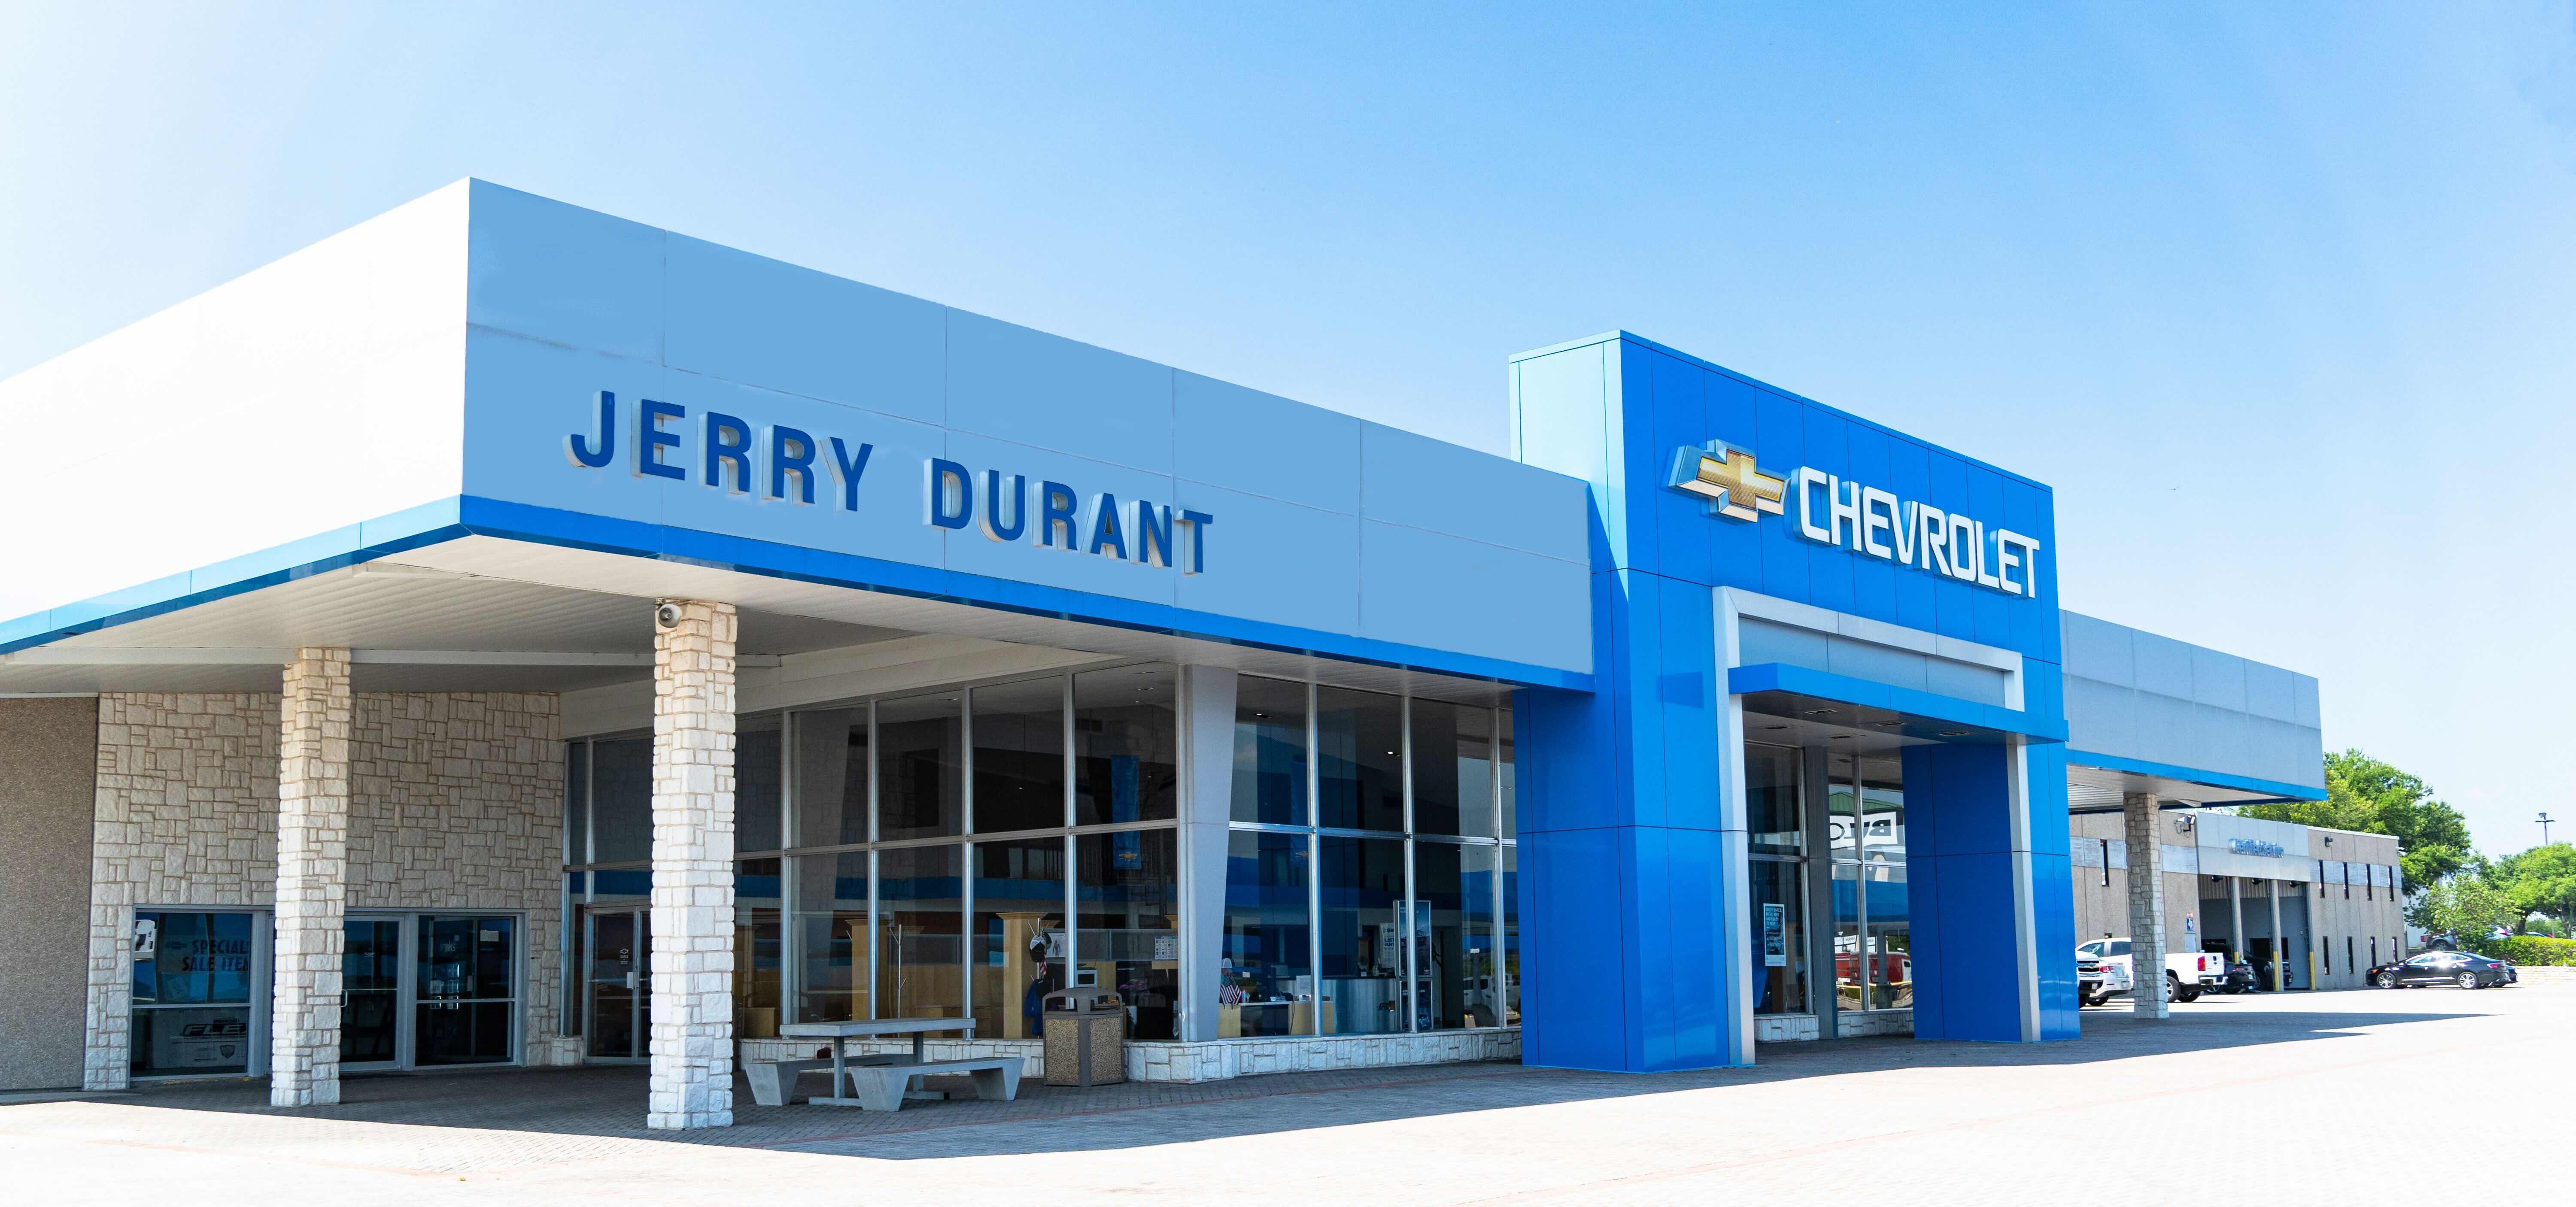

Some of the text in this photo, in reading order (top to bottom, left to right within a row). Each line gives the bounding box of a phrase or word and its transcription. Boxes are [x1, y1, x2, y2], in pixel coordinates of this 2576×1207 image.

[563, 390, 1213, 574] JERRY DURANT
[1793, 466, 2039, 598] CHEVROLET
[182, 956, 214, 971] SALE
[192, 940, 249, 954] SPECIAL
